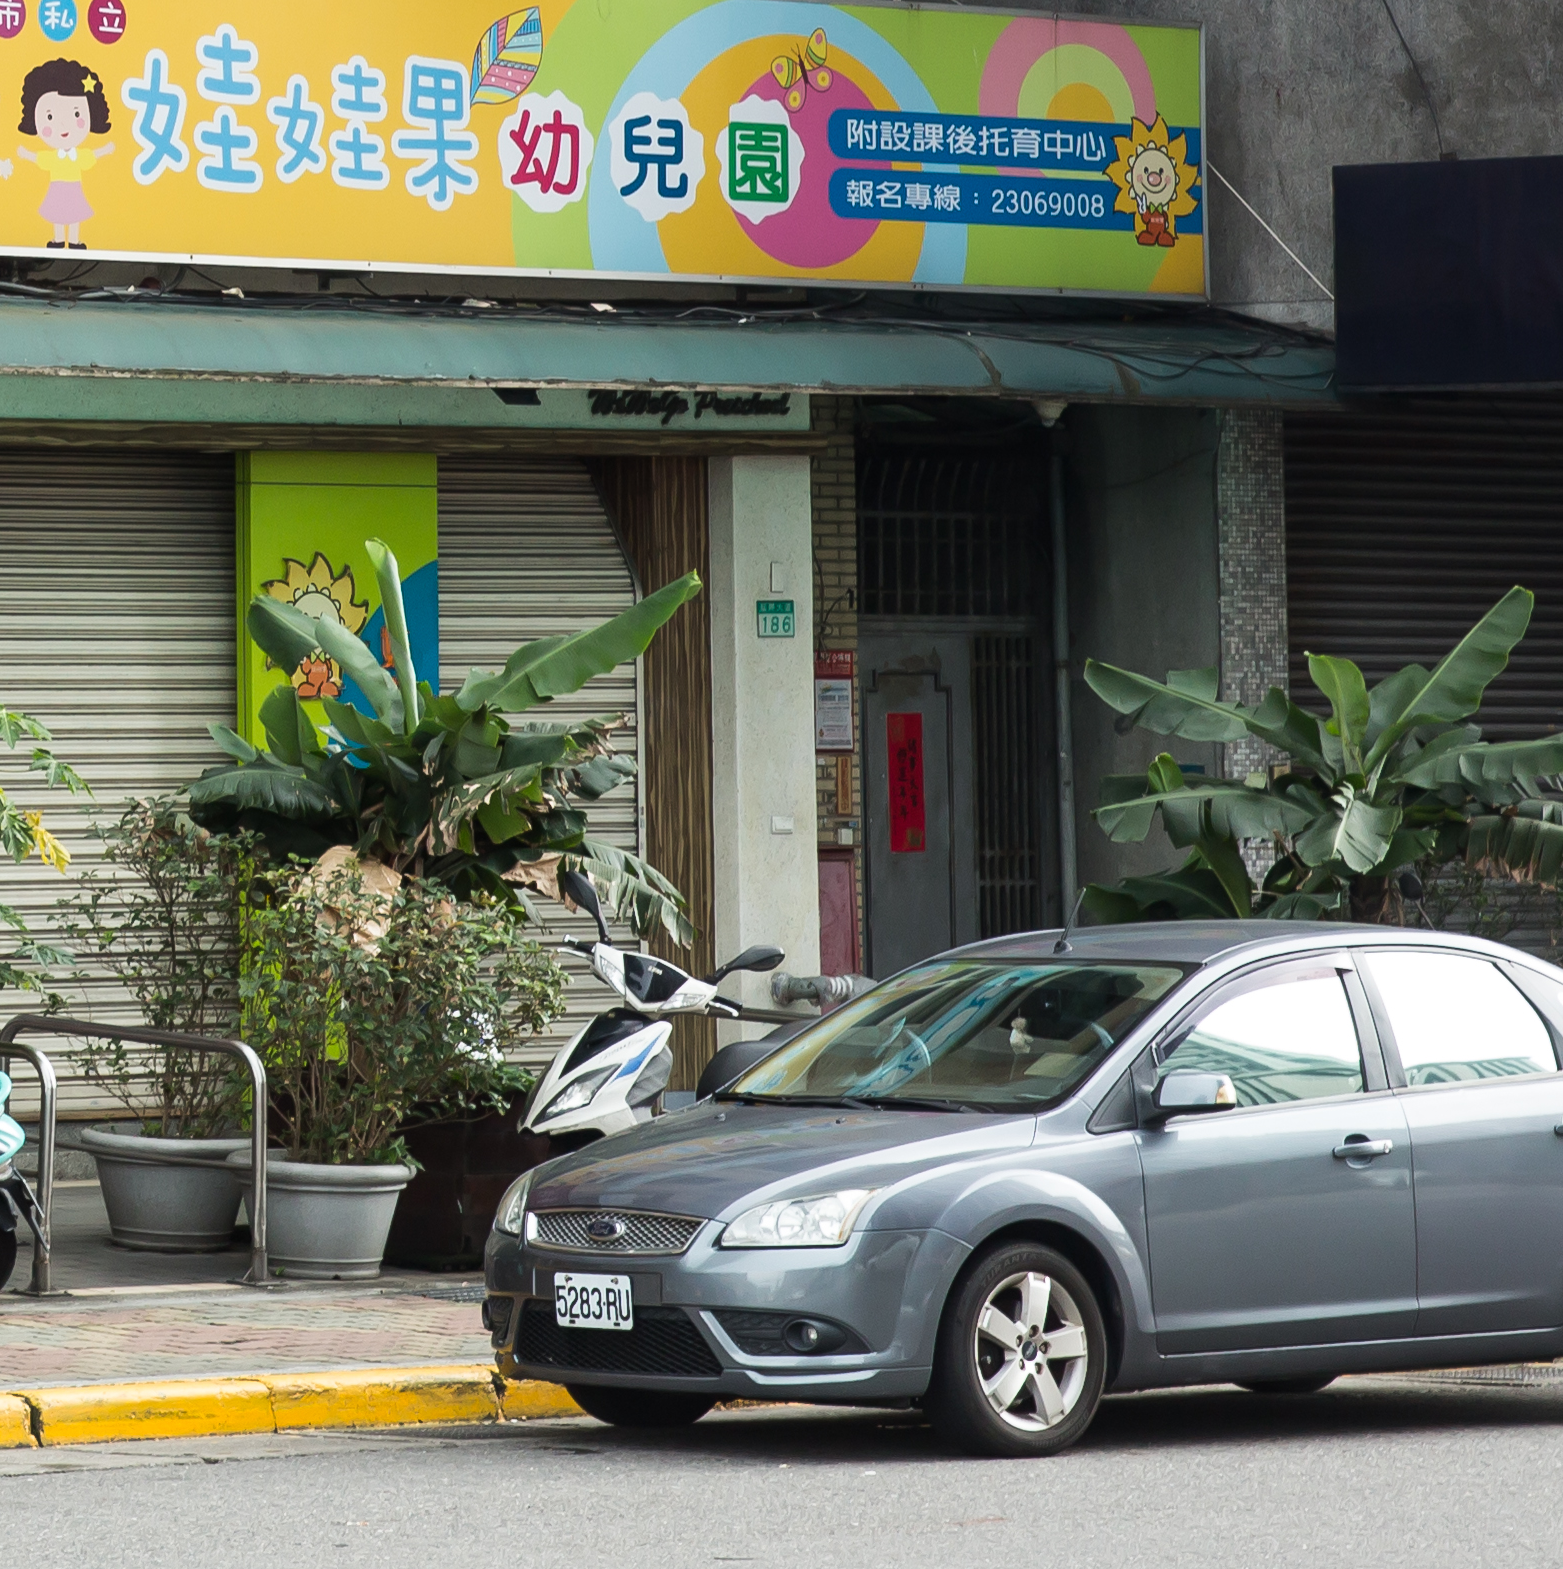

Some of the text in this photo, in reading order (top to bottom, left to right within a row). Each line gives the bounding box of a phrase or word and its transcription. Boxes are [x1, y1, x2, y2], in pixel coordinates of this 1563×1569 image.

[846, 118, 1107, 162] 附設課後托育中心
[991, 188, 1105, 218] 23069008
[763, 615, 791, 634] 186
